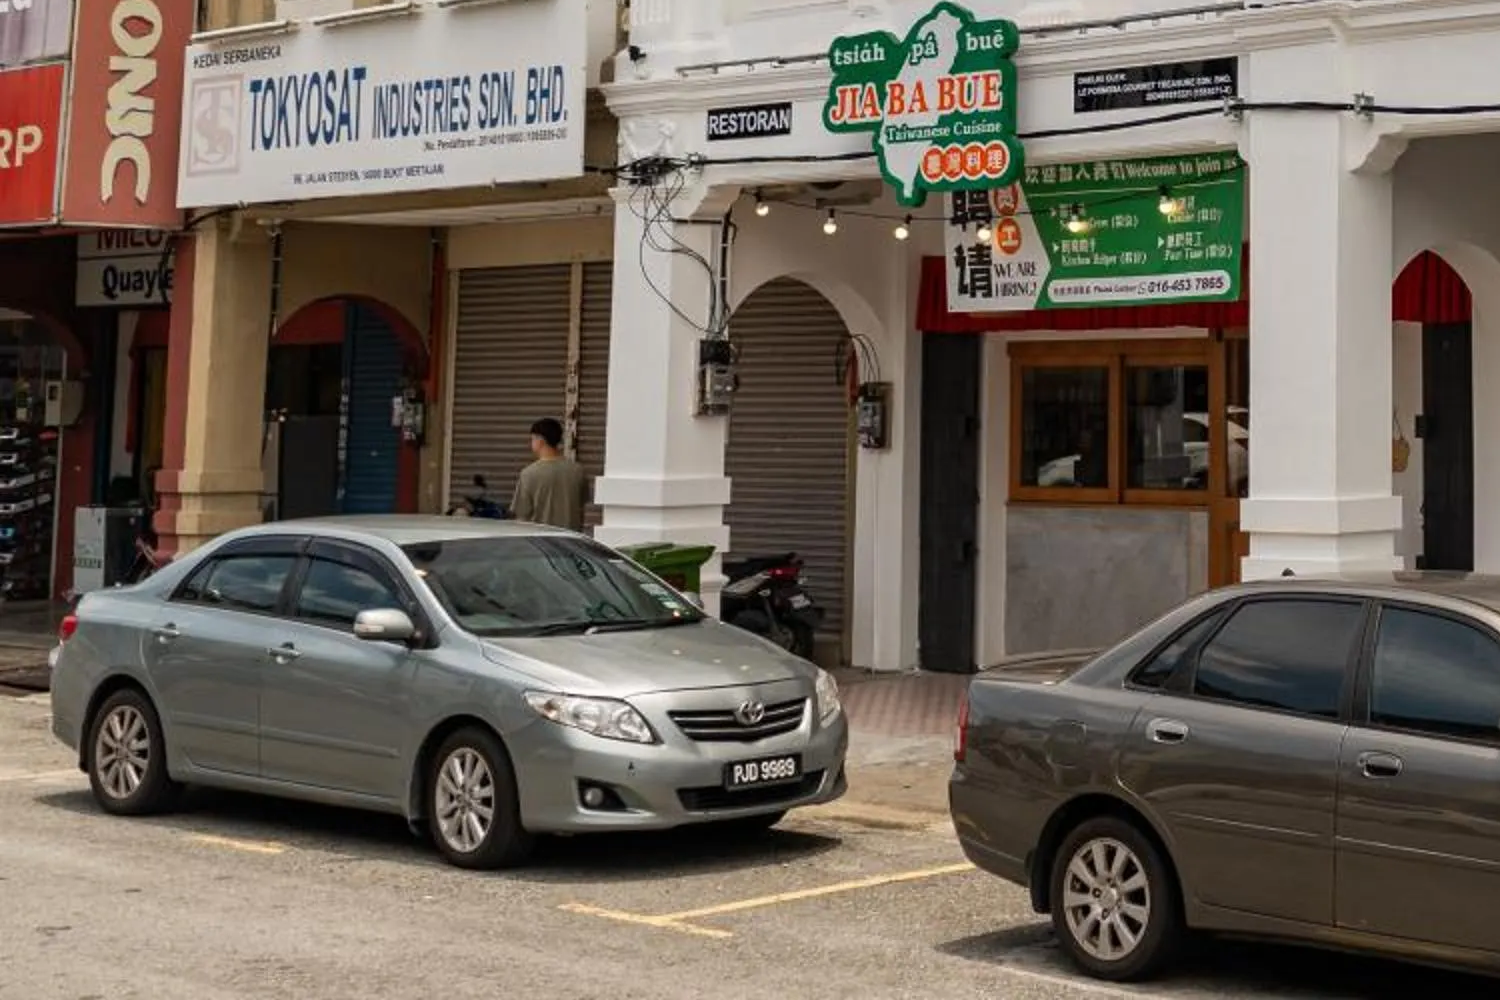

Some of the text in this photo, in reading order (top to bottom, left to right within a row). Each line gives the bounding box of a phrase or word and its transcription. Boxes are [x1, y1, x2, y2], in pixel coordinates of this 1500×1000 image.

[249, 65, 569, 152] TOKYOSAT INDUSTRIES SDN. BHD.
[831, 72, 1001, 121] JIA BA BUE
[708, 108, 790, 136] RESTORAN
[886, 120, 1001, 141] Taiwanese Cuisine
[733, 763, 759, 785] PJD
